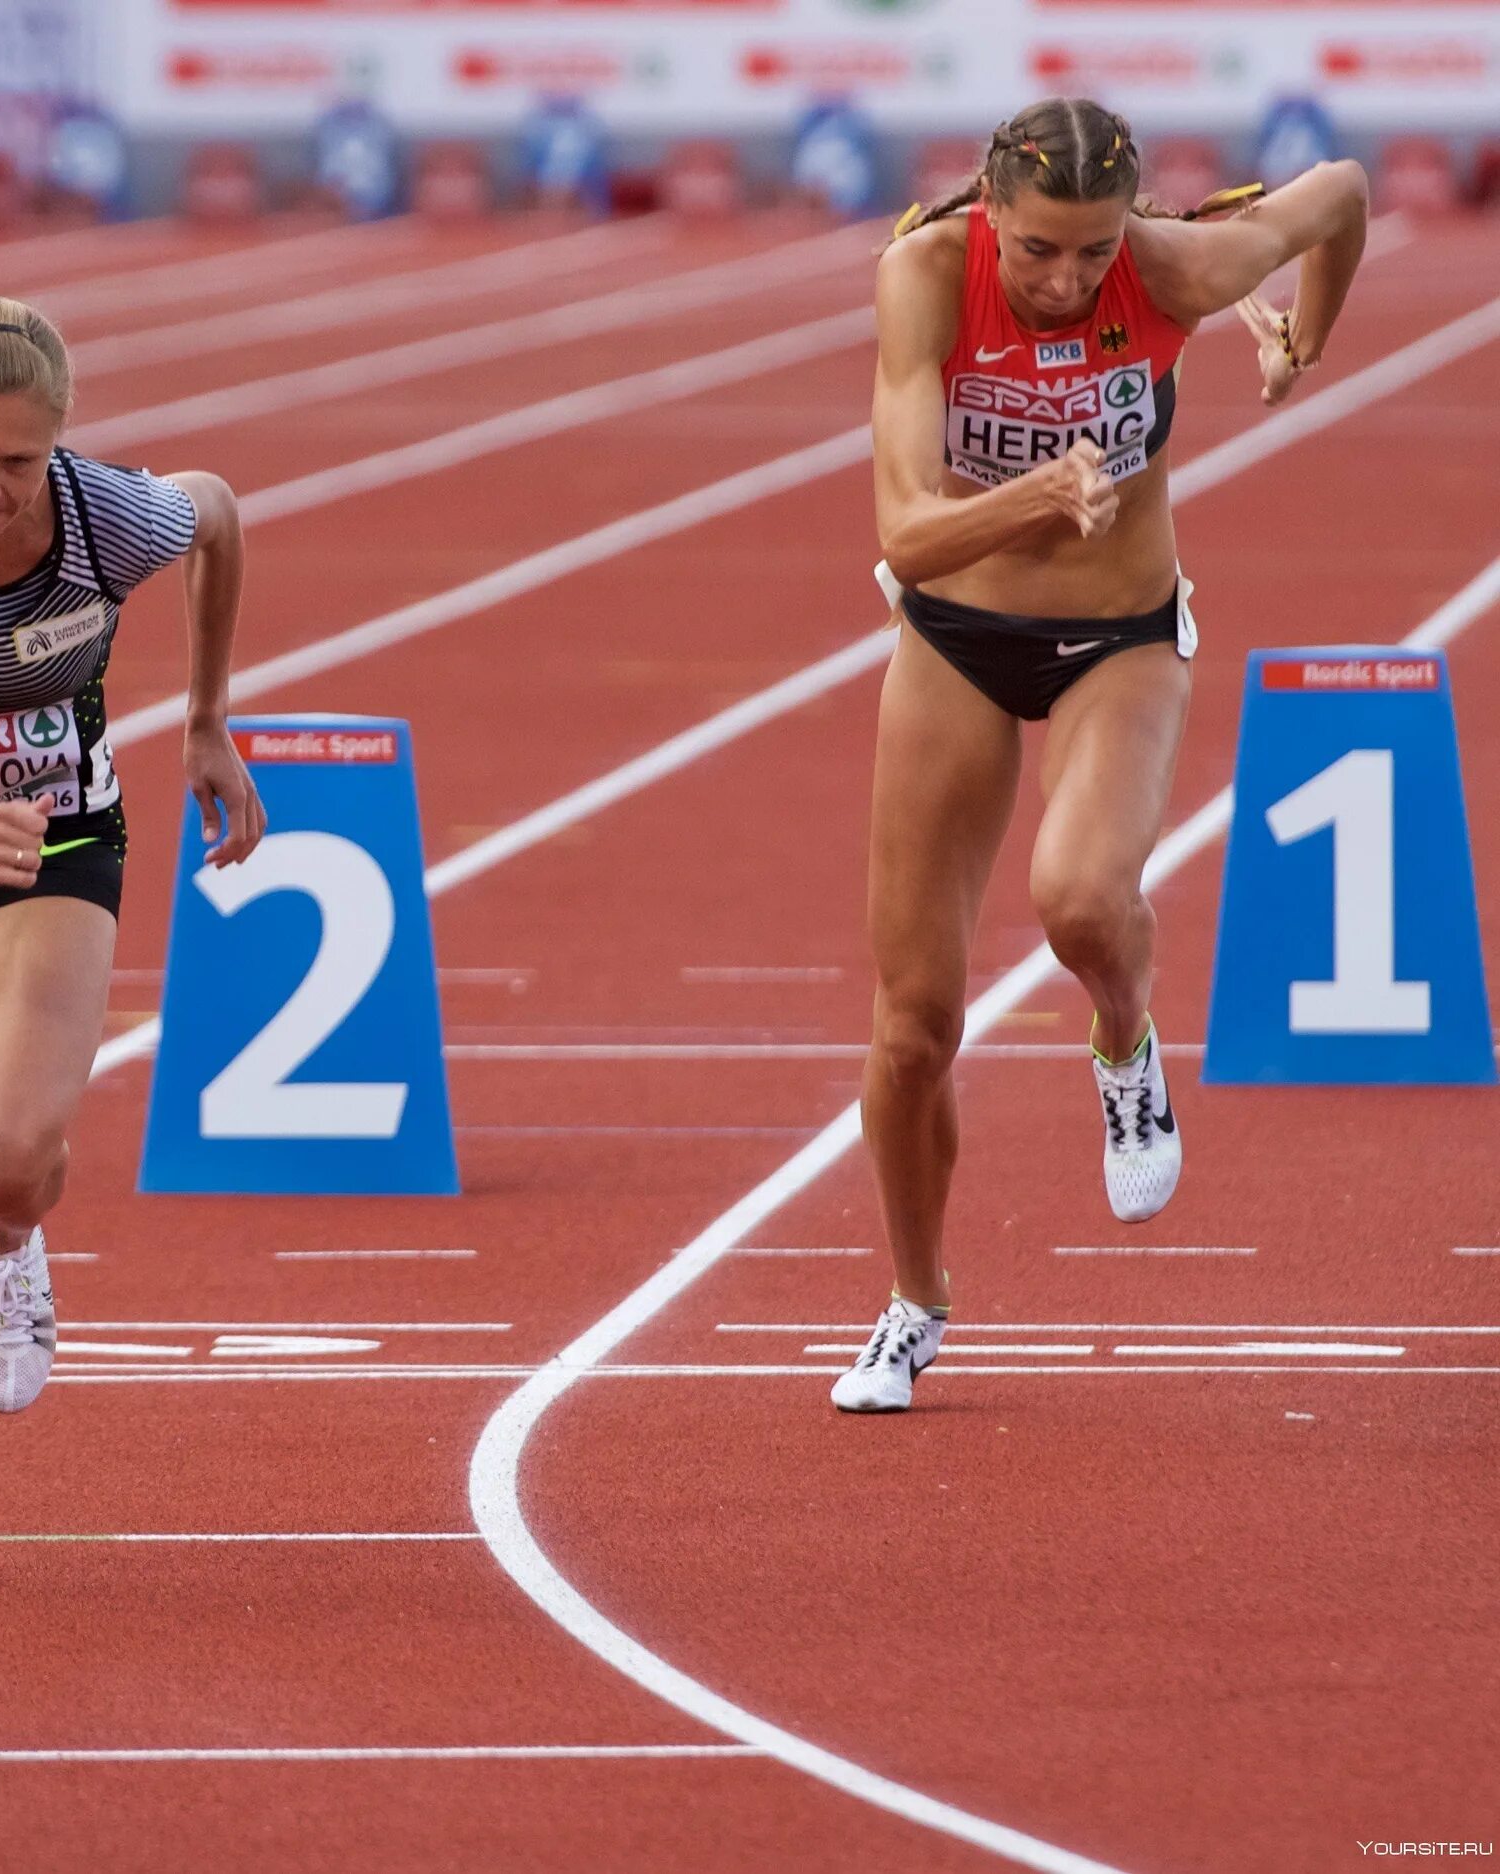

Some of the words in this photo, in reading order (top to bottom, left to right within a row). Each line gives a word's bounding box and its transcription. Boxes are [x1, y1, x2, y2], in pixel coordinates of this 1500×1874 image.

[1039, 343, 1082, 363] DKB
[959, 381, 1097, 422] SPAR
[962, 411, 1145, 461] HERING
[1303, 660, 1373, 682] Nordic
[1374, 661, 1435, 689] Sport
[252, 733, 325, 755] Nordic
[328, 734, 394, 763] Sport
[1265, 748, 1432, 1035] 1
[193, 831, 408, 1139] 2
